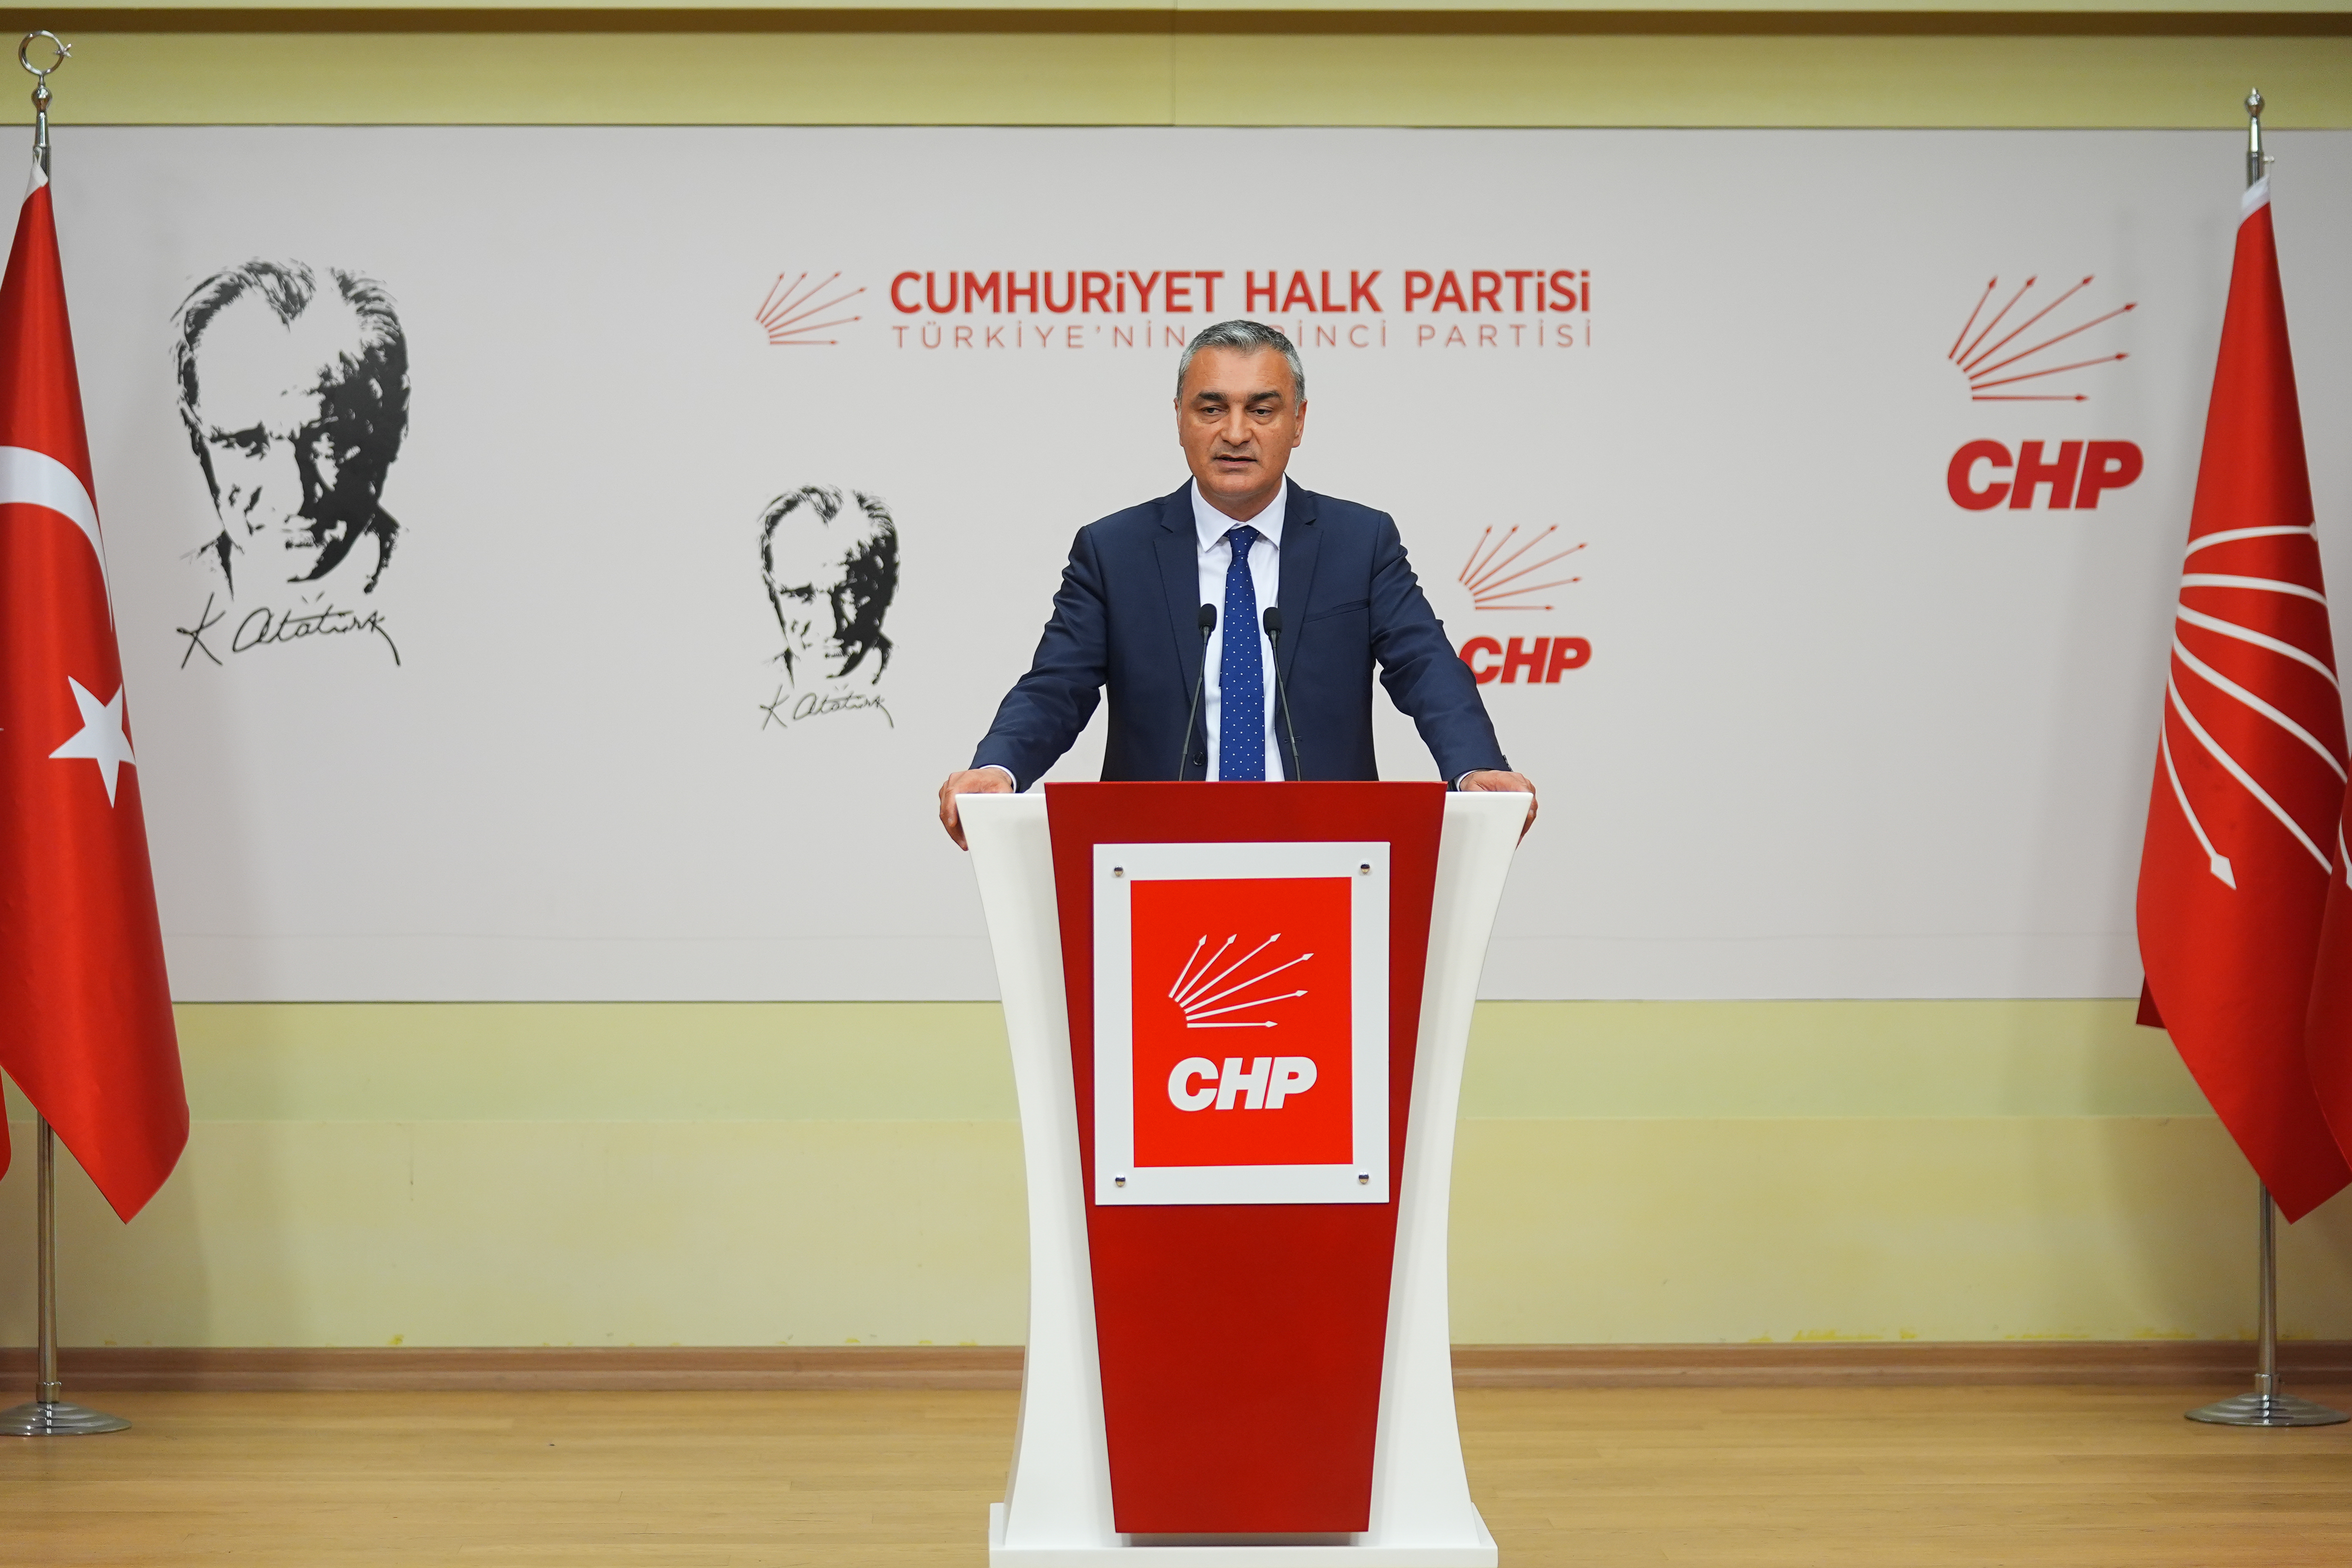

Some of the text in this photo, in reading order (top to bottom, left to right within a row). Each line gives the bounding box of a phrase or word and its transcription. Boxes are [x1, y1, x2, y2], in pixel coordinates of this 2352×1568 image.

[1246, 270, 1383, 313] HALK
[1250, 319, 1386, 348] İNCİ
[1418, 319, 1591, 348] PARTİSİ
[1947, 439, 2144, 511] CHP
[1459, 635, 1592, 685] CHP
[1168, 1056, 1318, 1112] CHP
